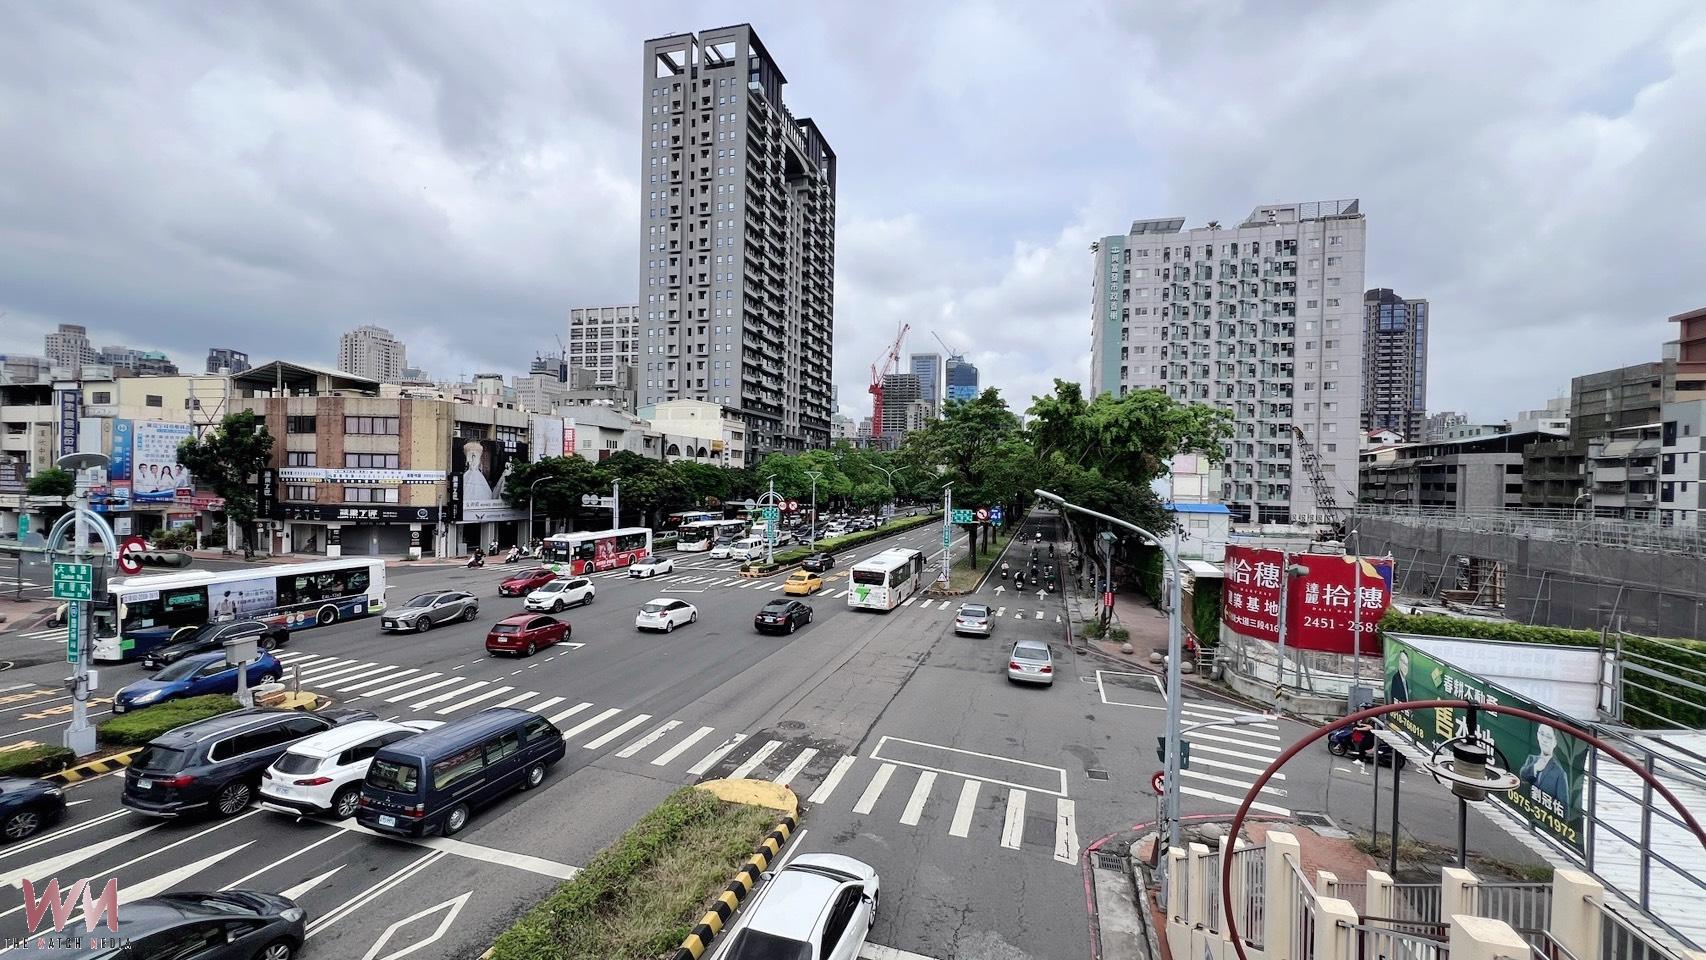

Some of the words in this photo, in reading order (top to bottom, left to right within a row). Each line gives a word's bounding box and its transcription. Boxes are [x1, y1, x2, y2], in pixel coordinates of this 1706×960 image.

[1304, 582, 1319, 604] 達麗
[1322, 583, 1383, 609] 拾穗
[1507, 788, 1576, 843] 0975-371972
